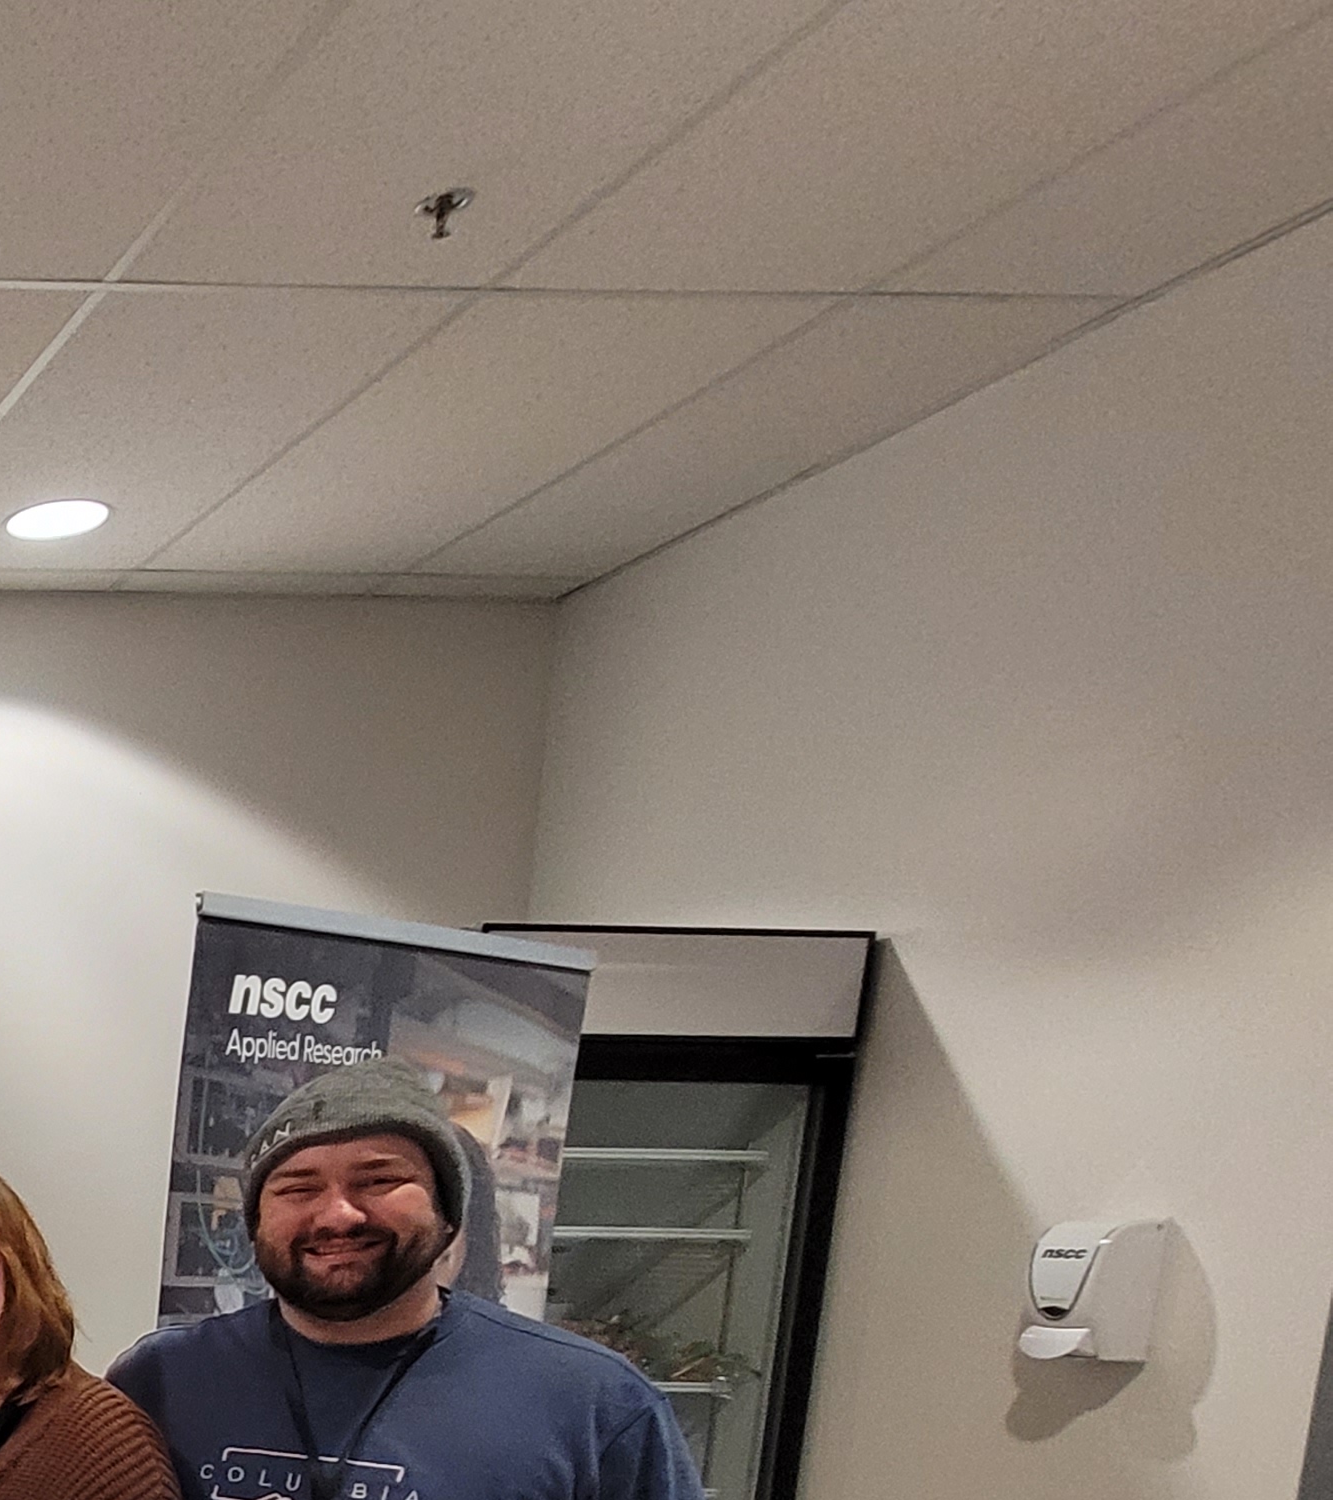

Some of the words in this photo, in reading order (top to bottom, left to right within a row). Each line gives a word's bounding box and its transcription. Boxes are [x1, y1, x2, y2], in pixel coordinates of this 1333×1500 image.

[228, 974, 338, 1025] nscc
[224, 1027, 302, 1064] Applied
[302, 1034, 383, 1066] Research
[1041, 1248, 1088, 1260] nscc
